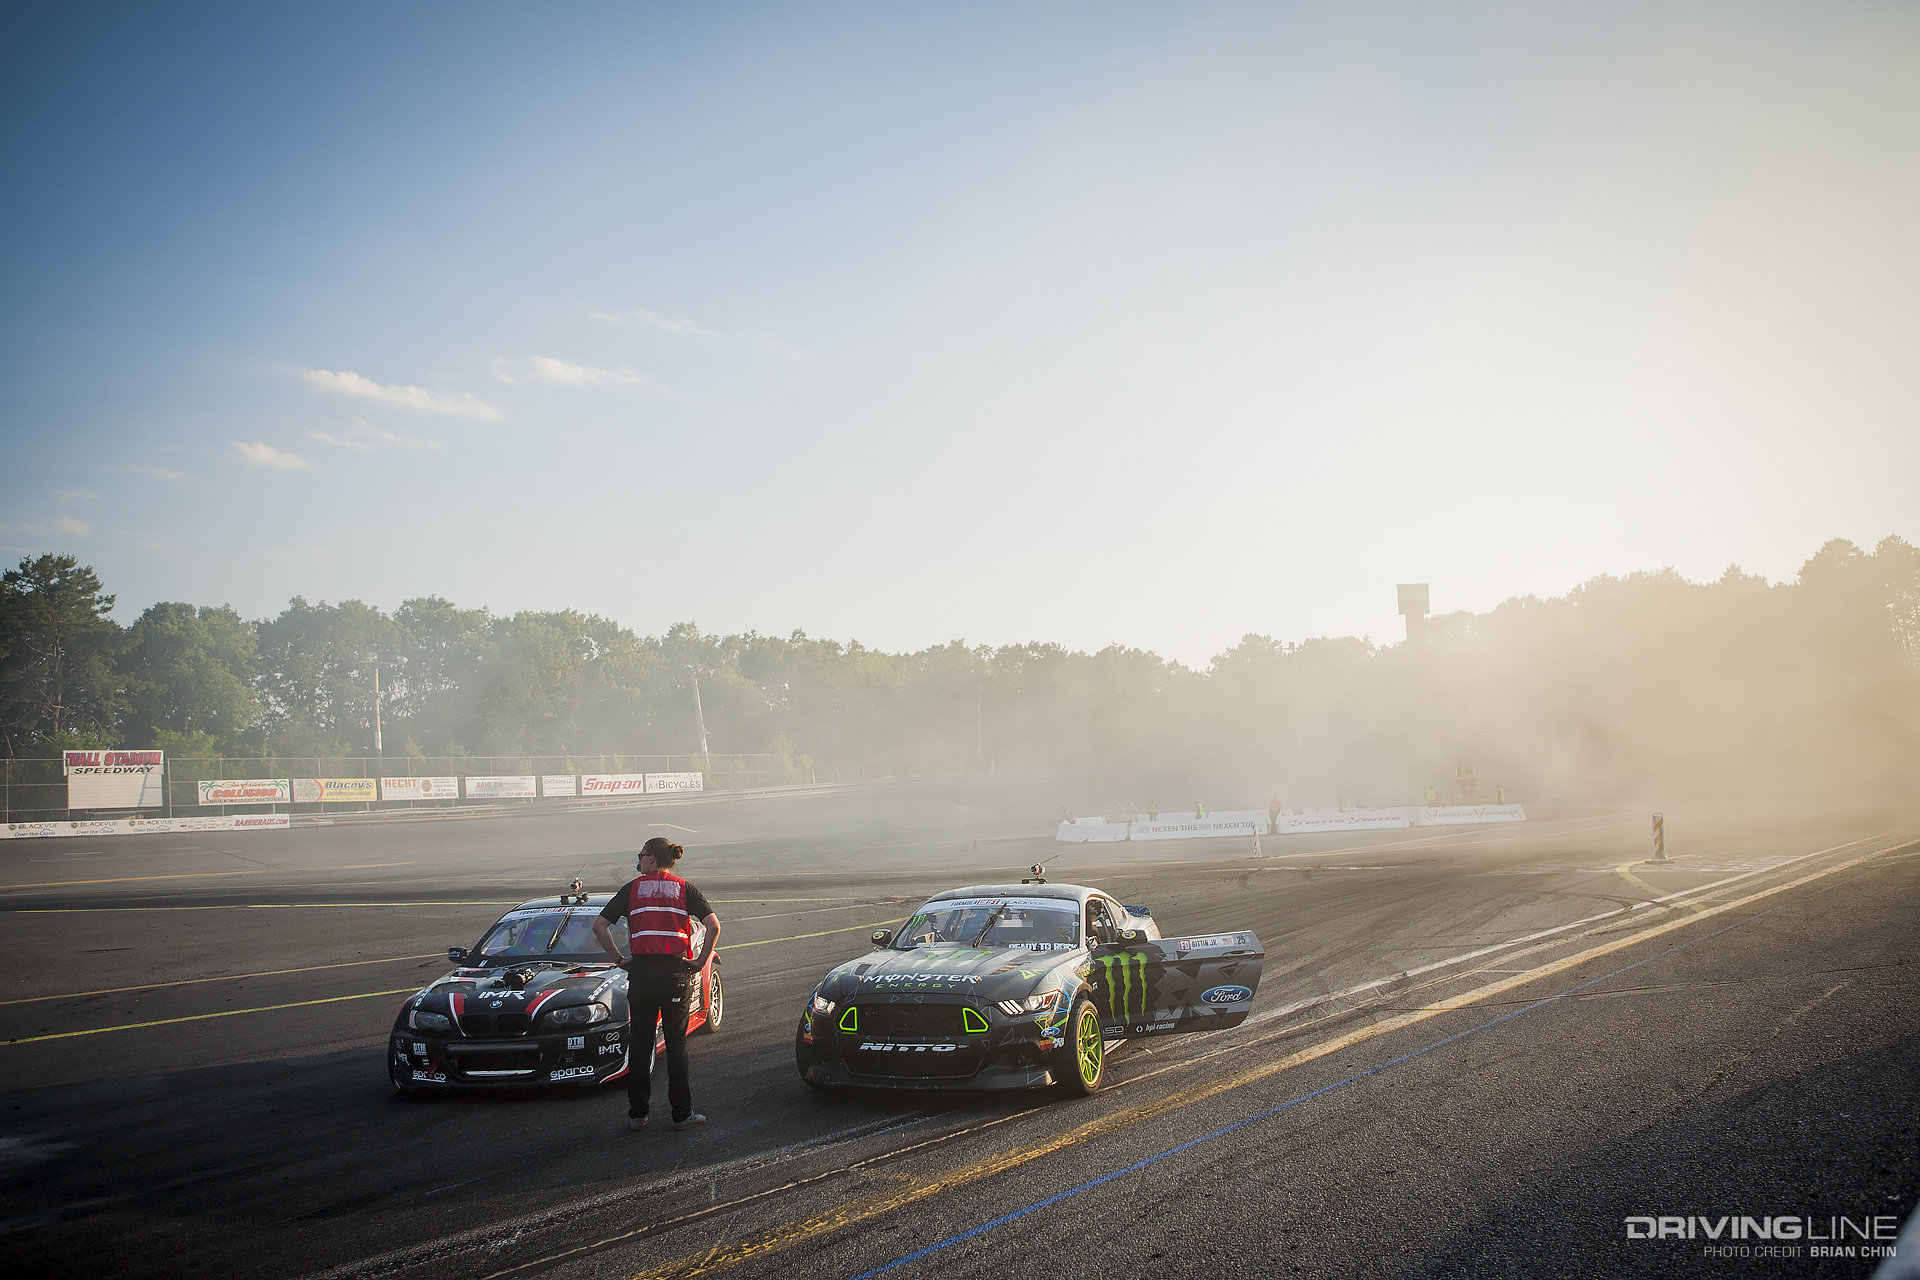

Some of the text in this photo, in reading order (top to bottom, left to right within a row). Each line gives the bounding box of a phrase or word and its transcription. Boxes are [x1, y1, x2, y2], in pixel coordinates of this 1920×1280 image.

[65, 752, 162, 767] WALL STADIUM
[74, 766, 154, 774] SPEEDWAY
[325, 781, 373, 790] Blacey's
[384, 779, 418, 788] HECHT
[584, 778, 642, 793] Snap-on
[659, 780, 701, 789] BICYCLES
[212, 788, 277, 798] COLLISION
[1192, 940, 1209, 948] GITTIN
[1237, 936, 1246, 945] 25
[478, 990, 526, 1000] IMR
[1210, 988, 1243, 1003] Ford
[598, 1043, 623, 1055] IMR
[859, 1042, 957, 1052] NITTO
[550, 1065, 594, 1081] sparco
